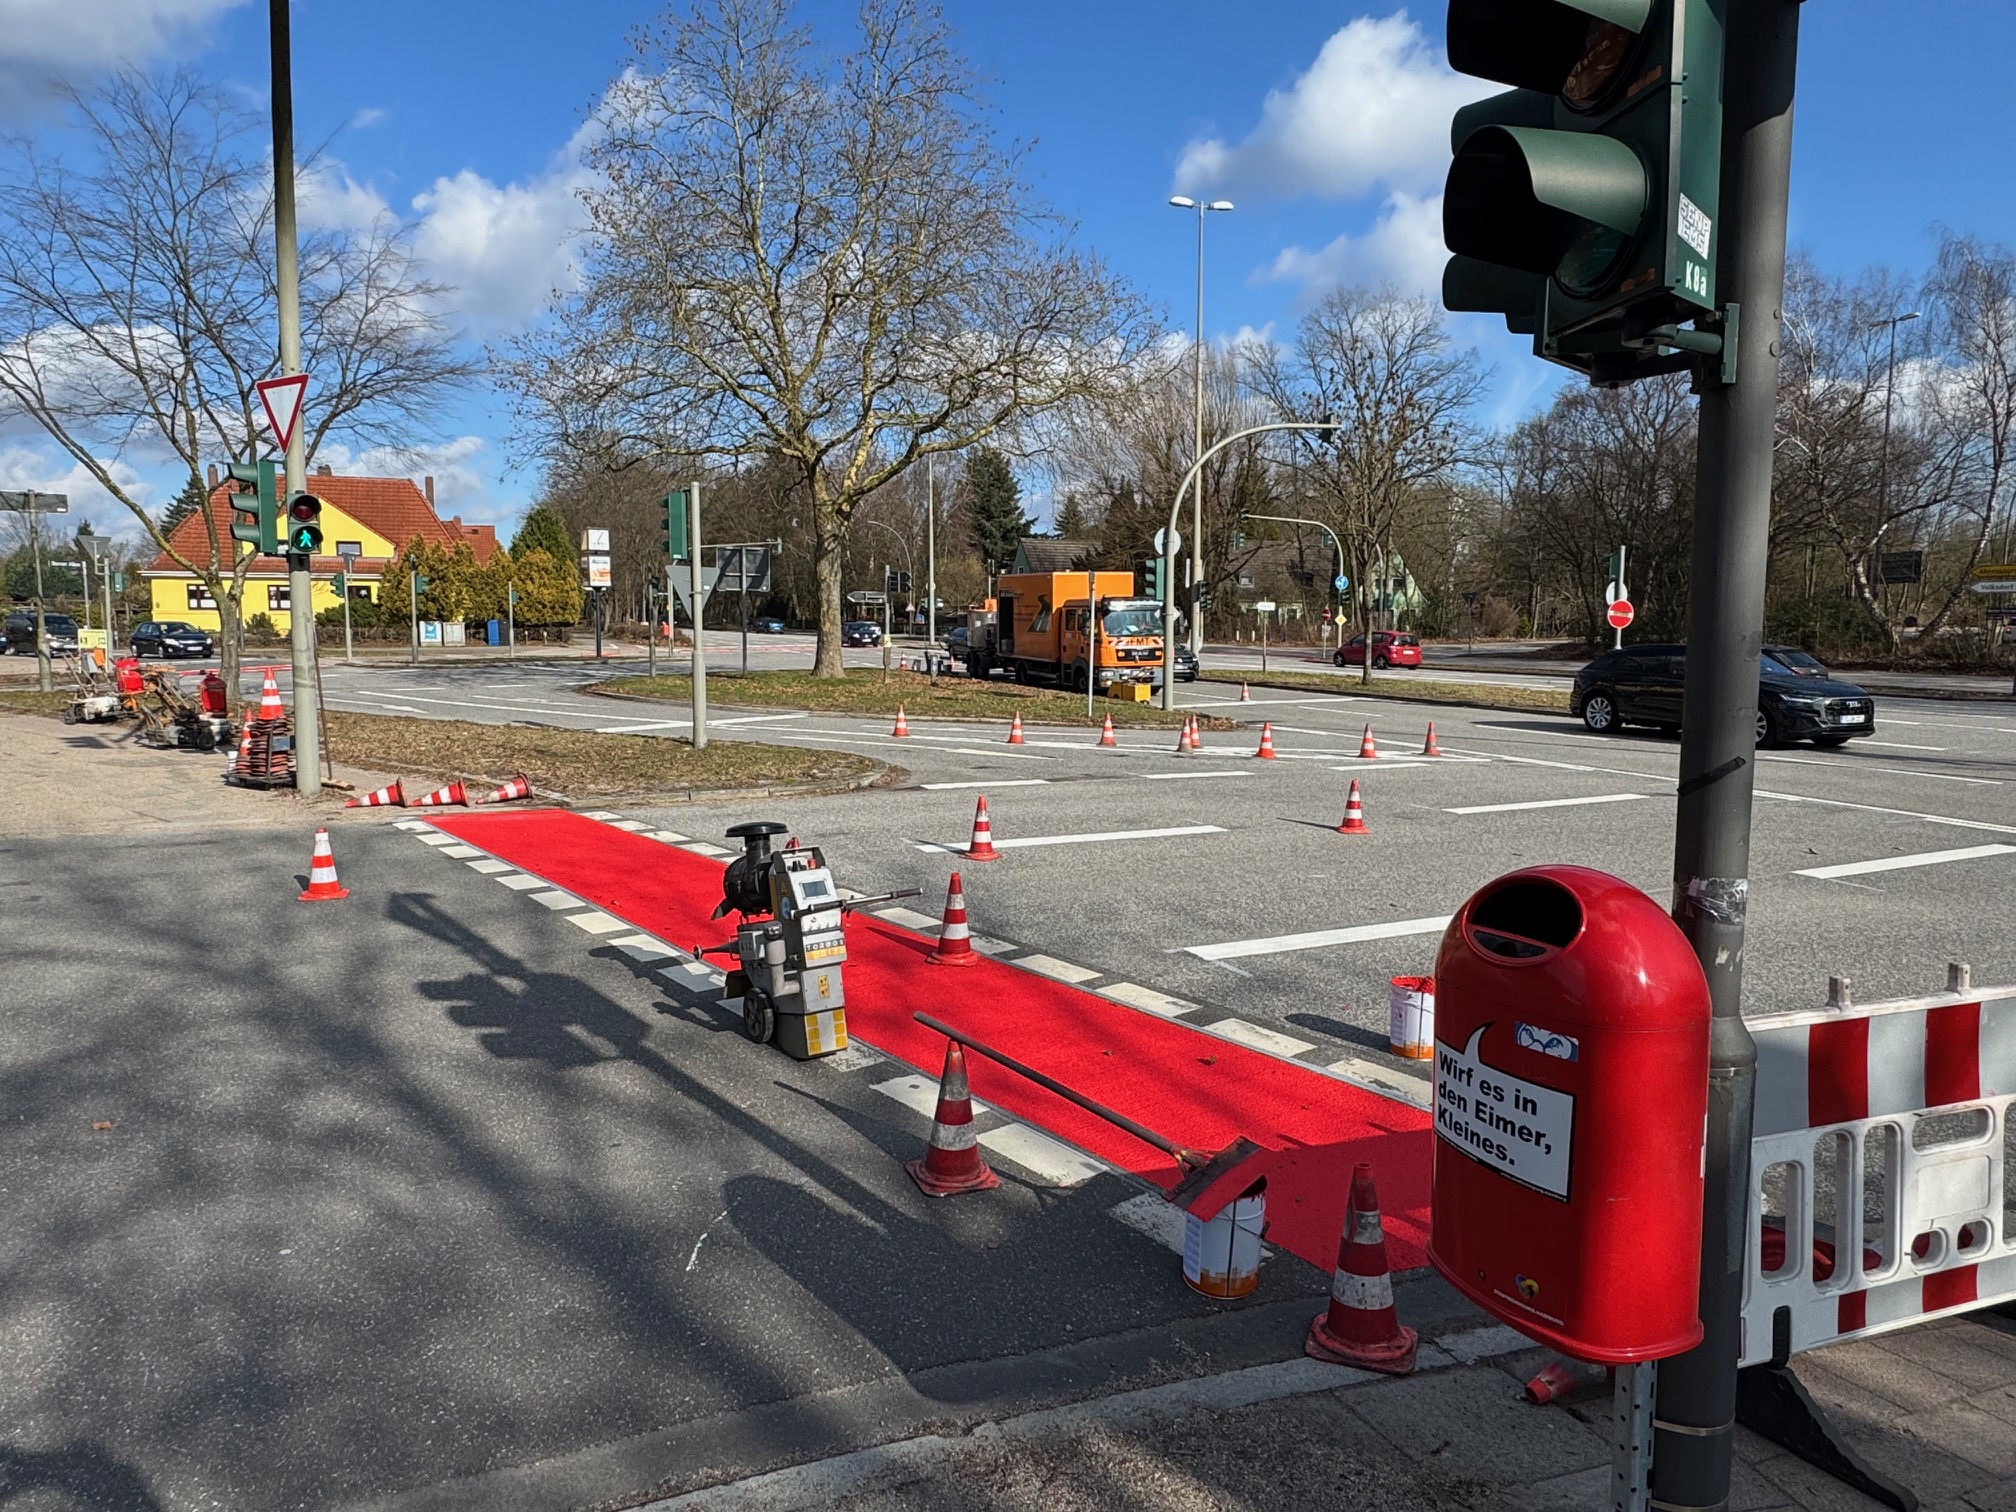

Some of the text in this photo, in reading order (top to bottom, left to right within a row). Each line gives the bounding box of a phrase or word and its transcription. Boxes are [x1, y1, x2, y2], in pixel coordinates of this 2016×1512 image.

[1685, 261, 1708, 297] K8a
[1439, 1051, 1538, 1116] Wirf es in
[1438, 1081, 1468, 1113] den
[1475, 1099, 1552, 1155] Eimer,
[1438, 1103, 1515, 1166] Kleines.
